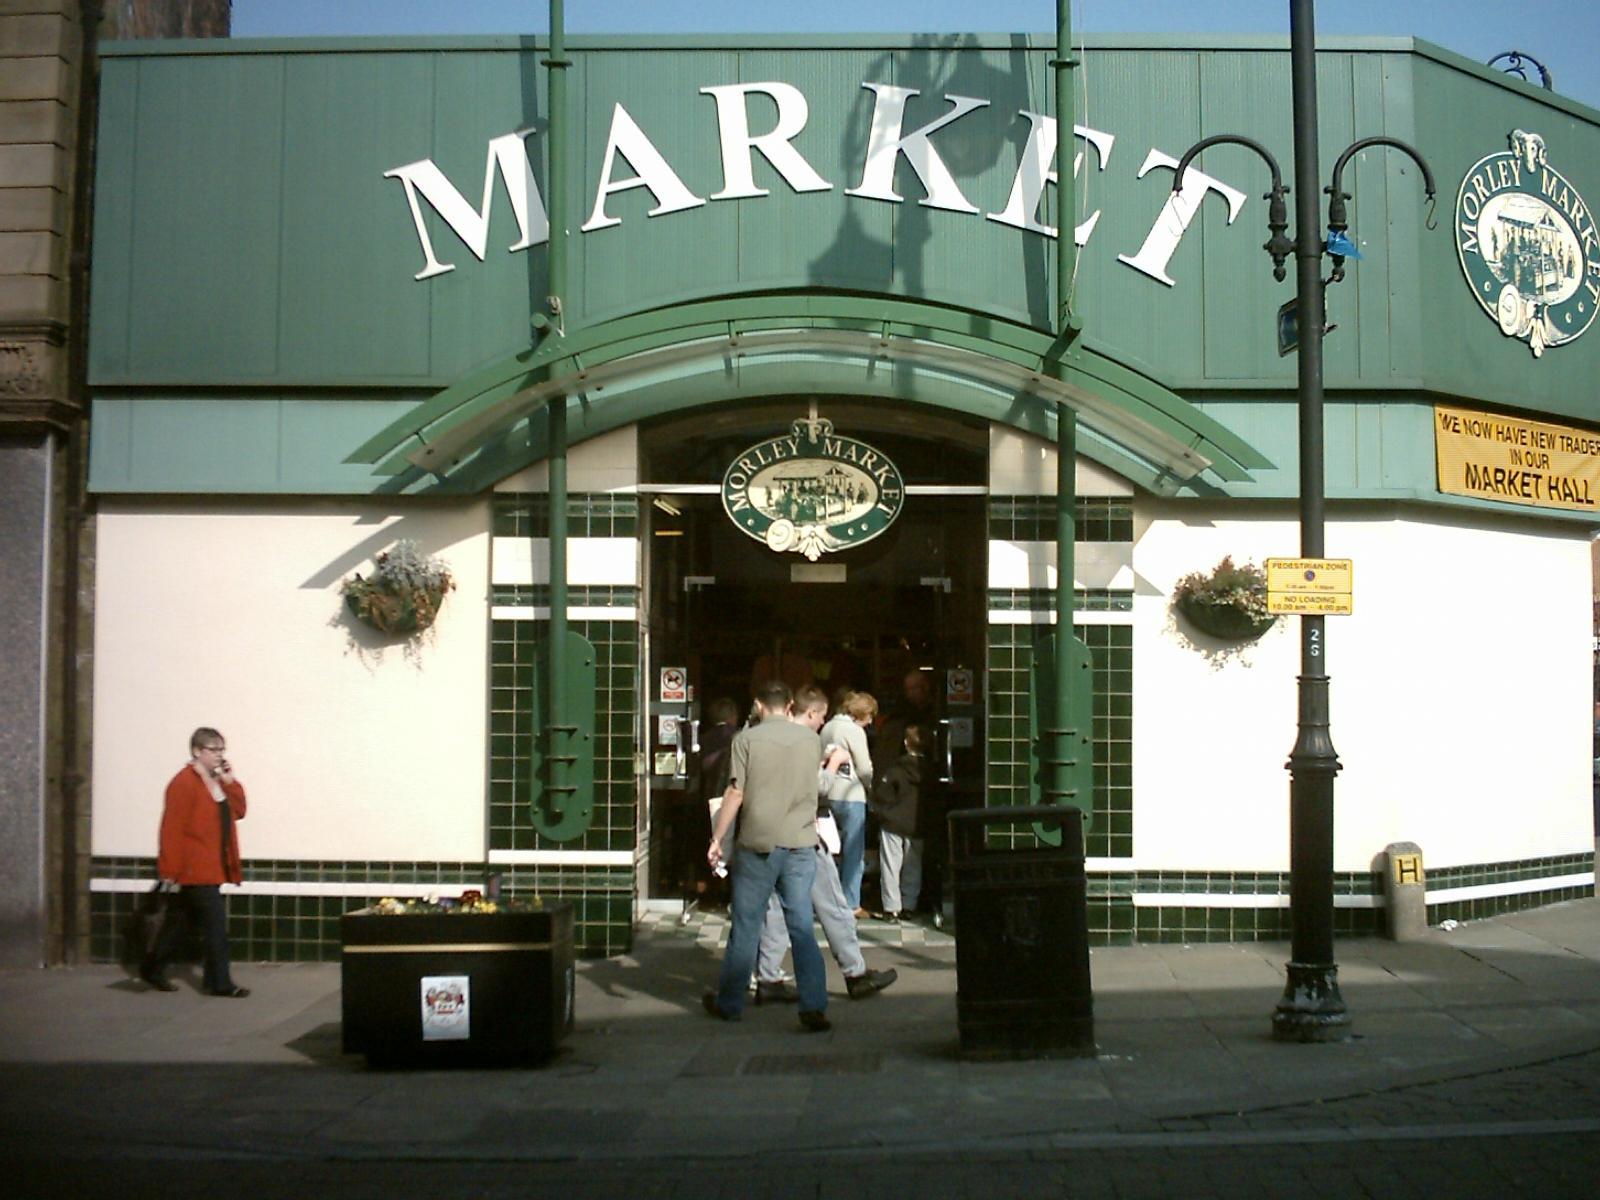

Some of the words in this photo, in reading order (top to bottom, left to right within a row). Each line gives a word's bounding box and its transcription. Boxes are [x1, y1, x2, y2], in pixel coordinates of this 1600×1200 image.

[383, 81, 1248, 286] MARKET
[1461, 159, 1521, 254] MORLEY
[1541, 168, 1600, 305] MARKET
[1439, 413, 1461, 433] WE
[1463, 418, 1493, 441] NOW
[1496, 424, 1527, 445] HAVE
[1531, 431, 1556, 449] NEW
[728, 438, 800, 512] MORLEY
[822, 438, 899, 519] MARKET
[1509, 448, 1522, 465] IN
[1526, 451, 1550, 469] OUR
[1465, 462, 1542, 499] MARKET
[1548, 475, 1594, 504] HALL
[1398, 857, 1418, 884] H
